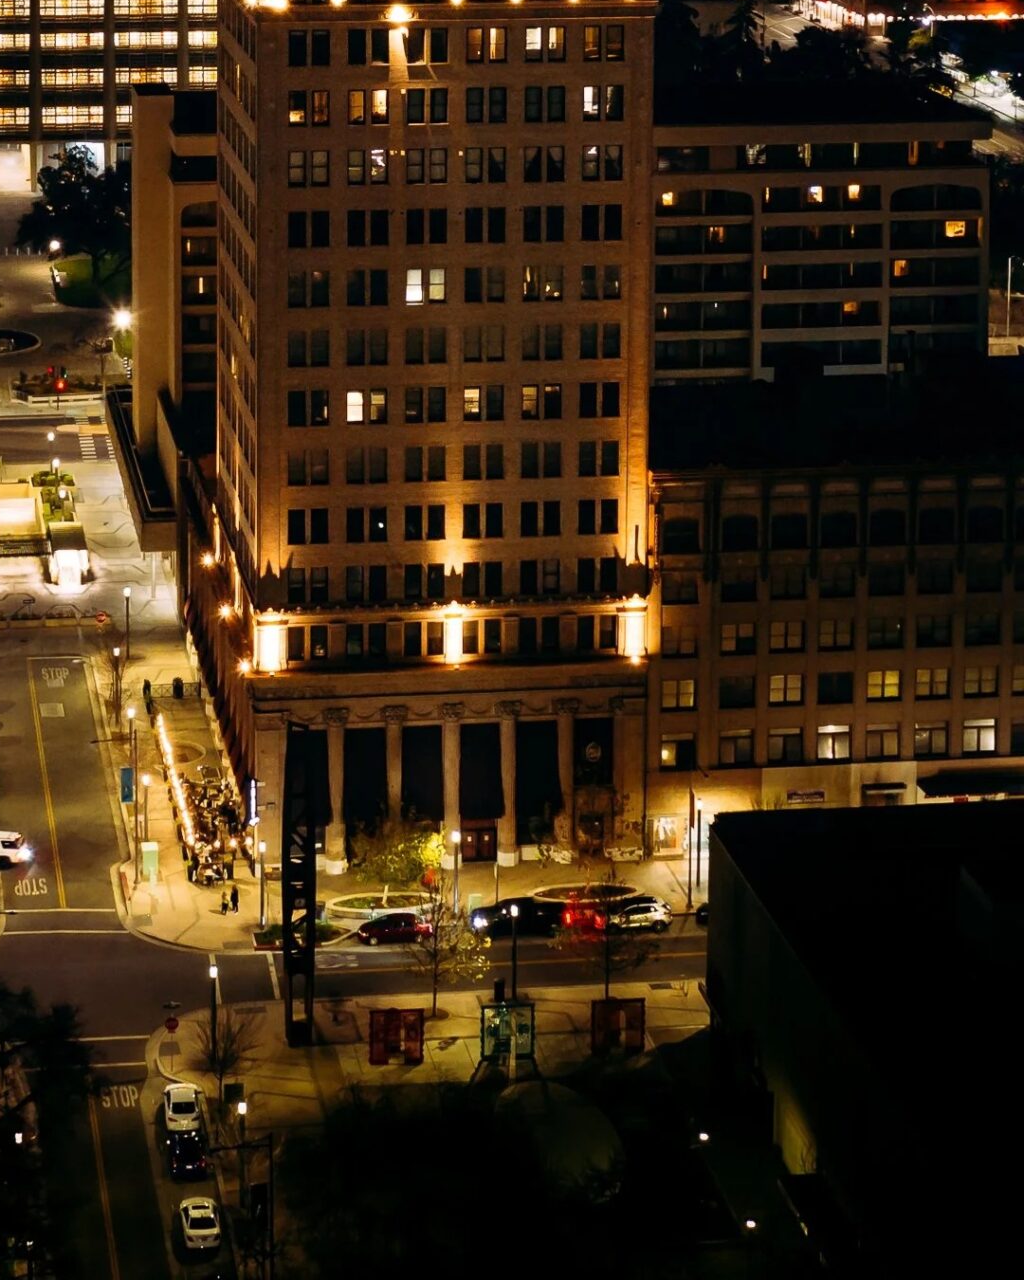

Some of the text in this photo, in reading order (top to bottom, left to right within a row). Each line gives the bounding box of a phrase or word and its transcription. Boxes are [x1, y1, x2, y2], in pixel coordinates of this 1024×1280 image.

[41, 667, 69, 680] STOP
[15, 878, 47, 896] STOP
[101, 1084, 138, 1108] STOP
